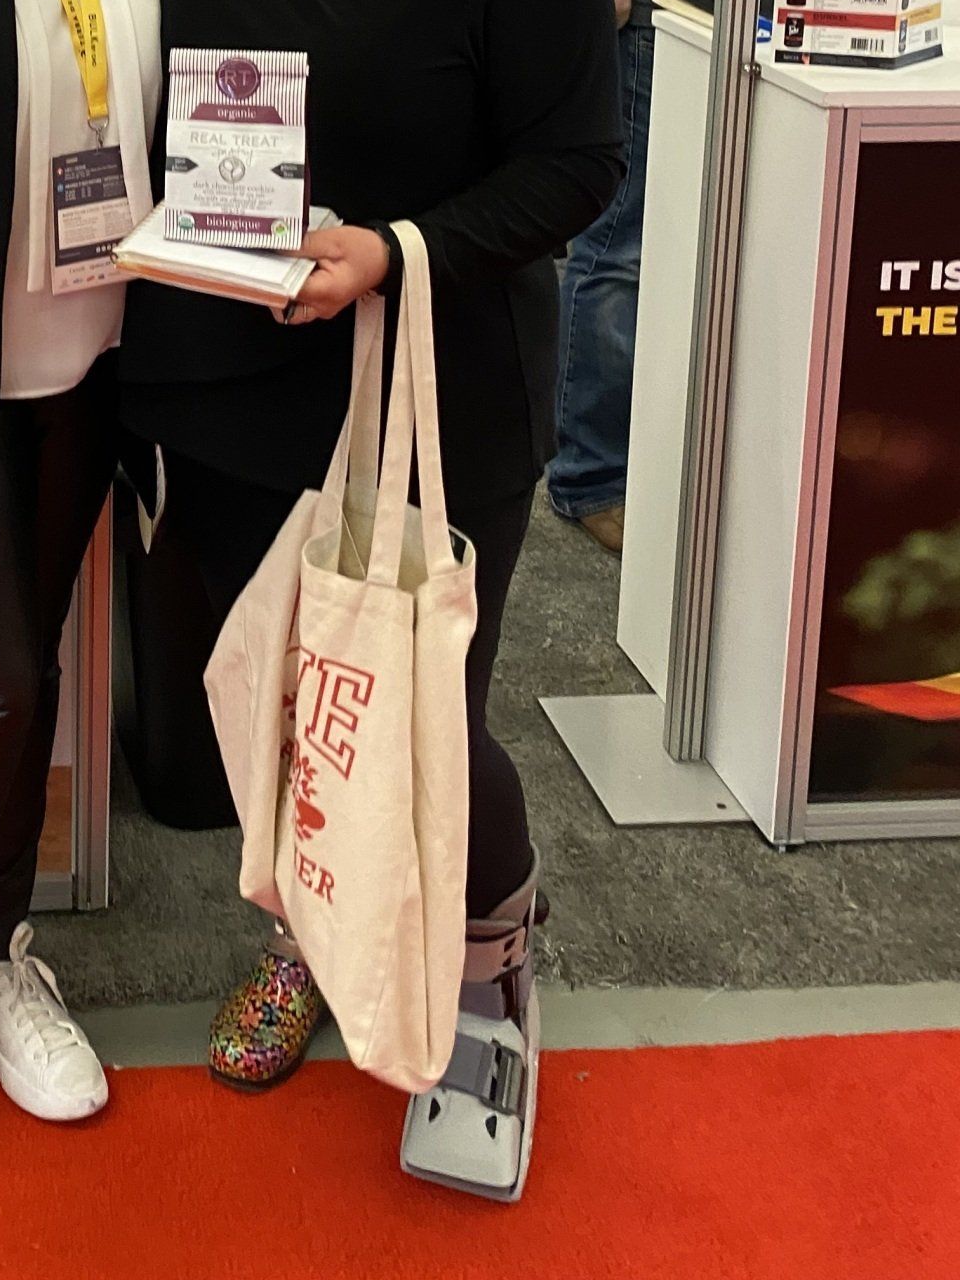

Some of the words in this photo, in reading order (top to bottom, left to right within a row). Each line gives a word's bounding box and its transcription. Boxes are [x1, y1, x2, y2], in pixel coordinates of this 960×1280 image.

[224, 69, 251, 87] RT
[217, 107, 257, 121] organic
[189, 130, 227, 146] REAL
[231, 133, 279, 148] TREAT
[205, 215, 262, 231] biologique
[880, 261, 920, 291] IT
[876, 306, 958, 336] THE
